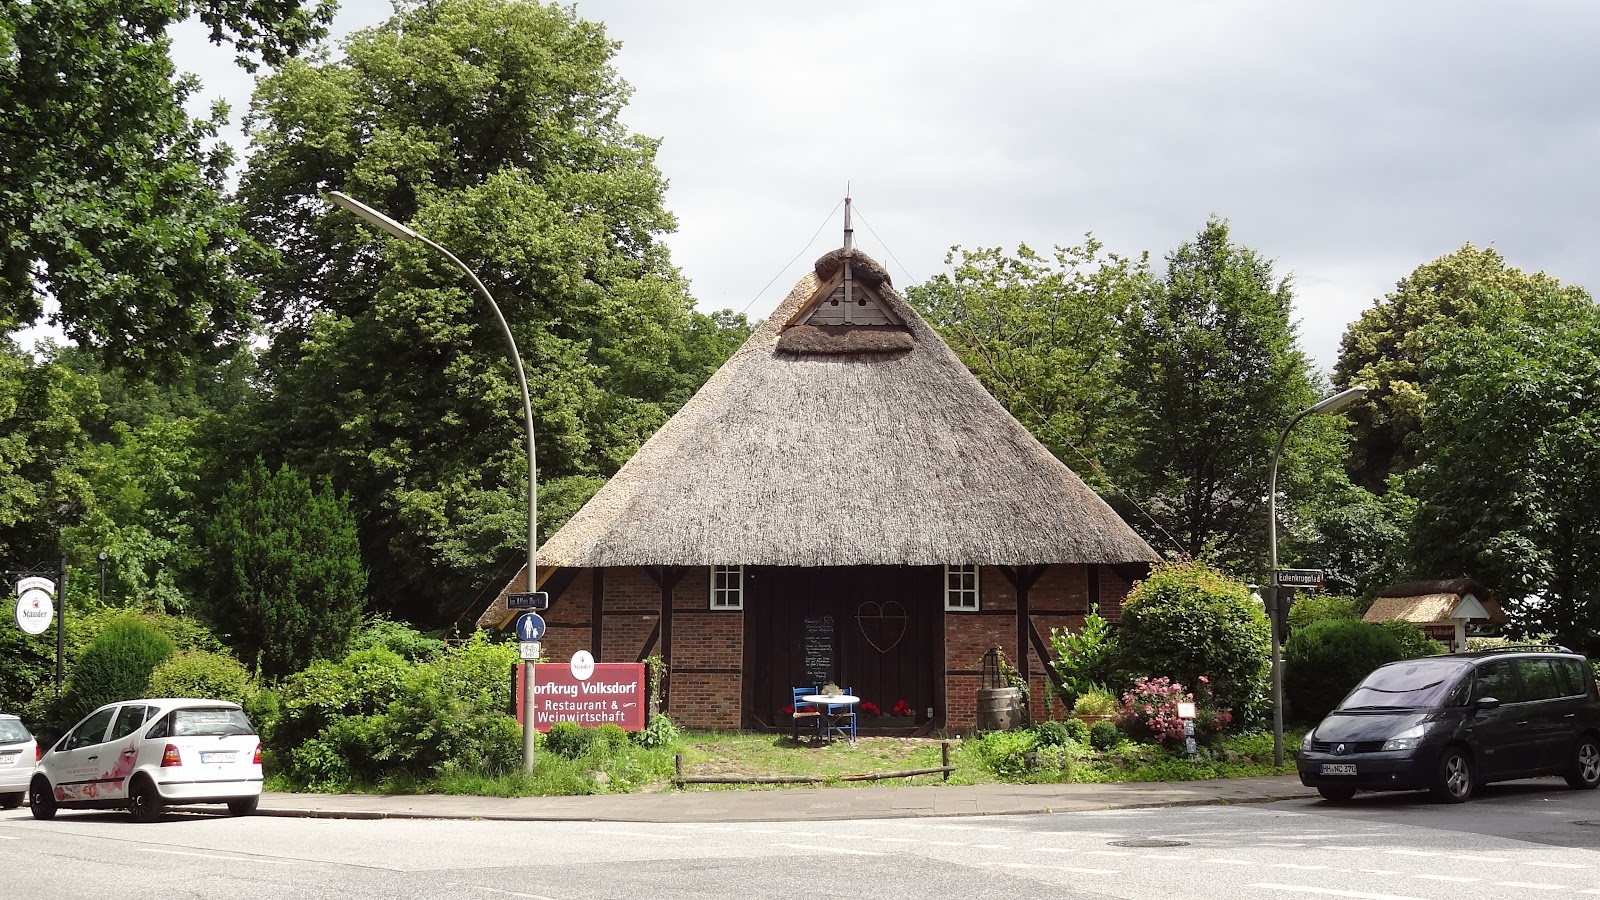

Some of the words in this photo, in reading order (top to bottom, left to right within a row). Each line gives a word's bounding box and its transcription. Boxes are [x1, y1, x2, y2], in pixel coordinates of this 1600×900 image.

[1278, 573, 1321, 584] Eulenkrugpfad
[533, 682, 579, 698] orfkrug
[581, 681, 638, 695] Volksdorf
[545, 699, 607, 711] Restaurant
[610, 700, 619, 710] &
[537, 710, 626, 723] Weinwirtschaft
